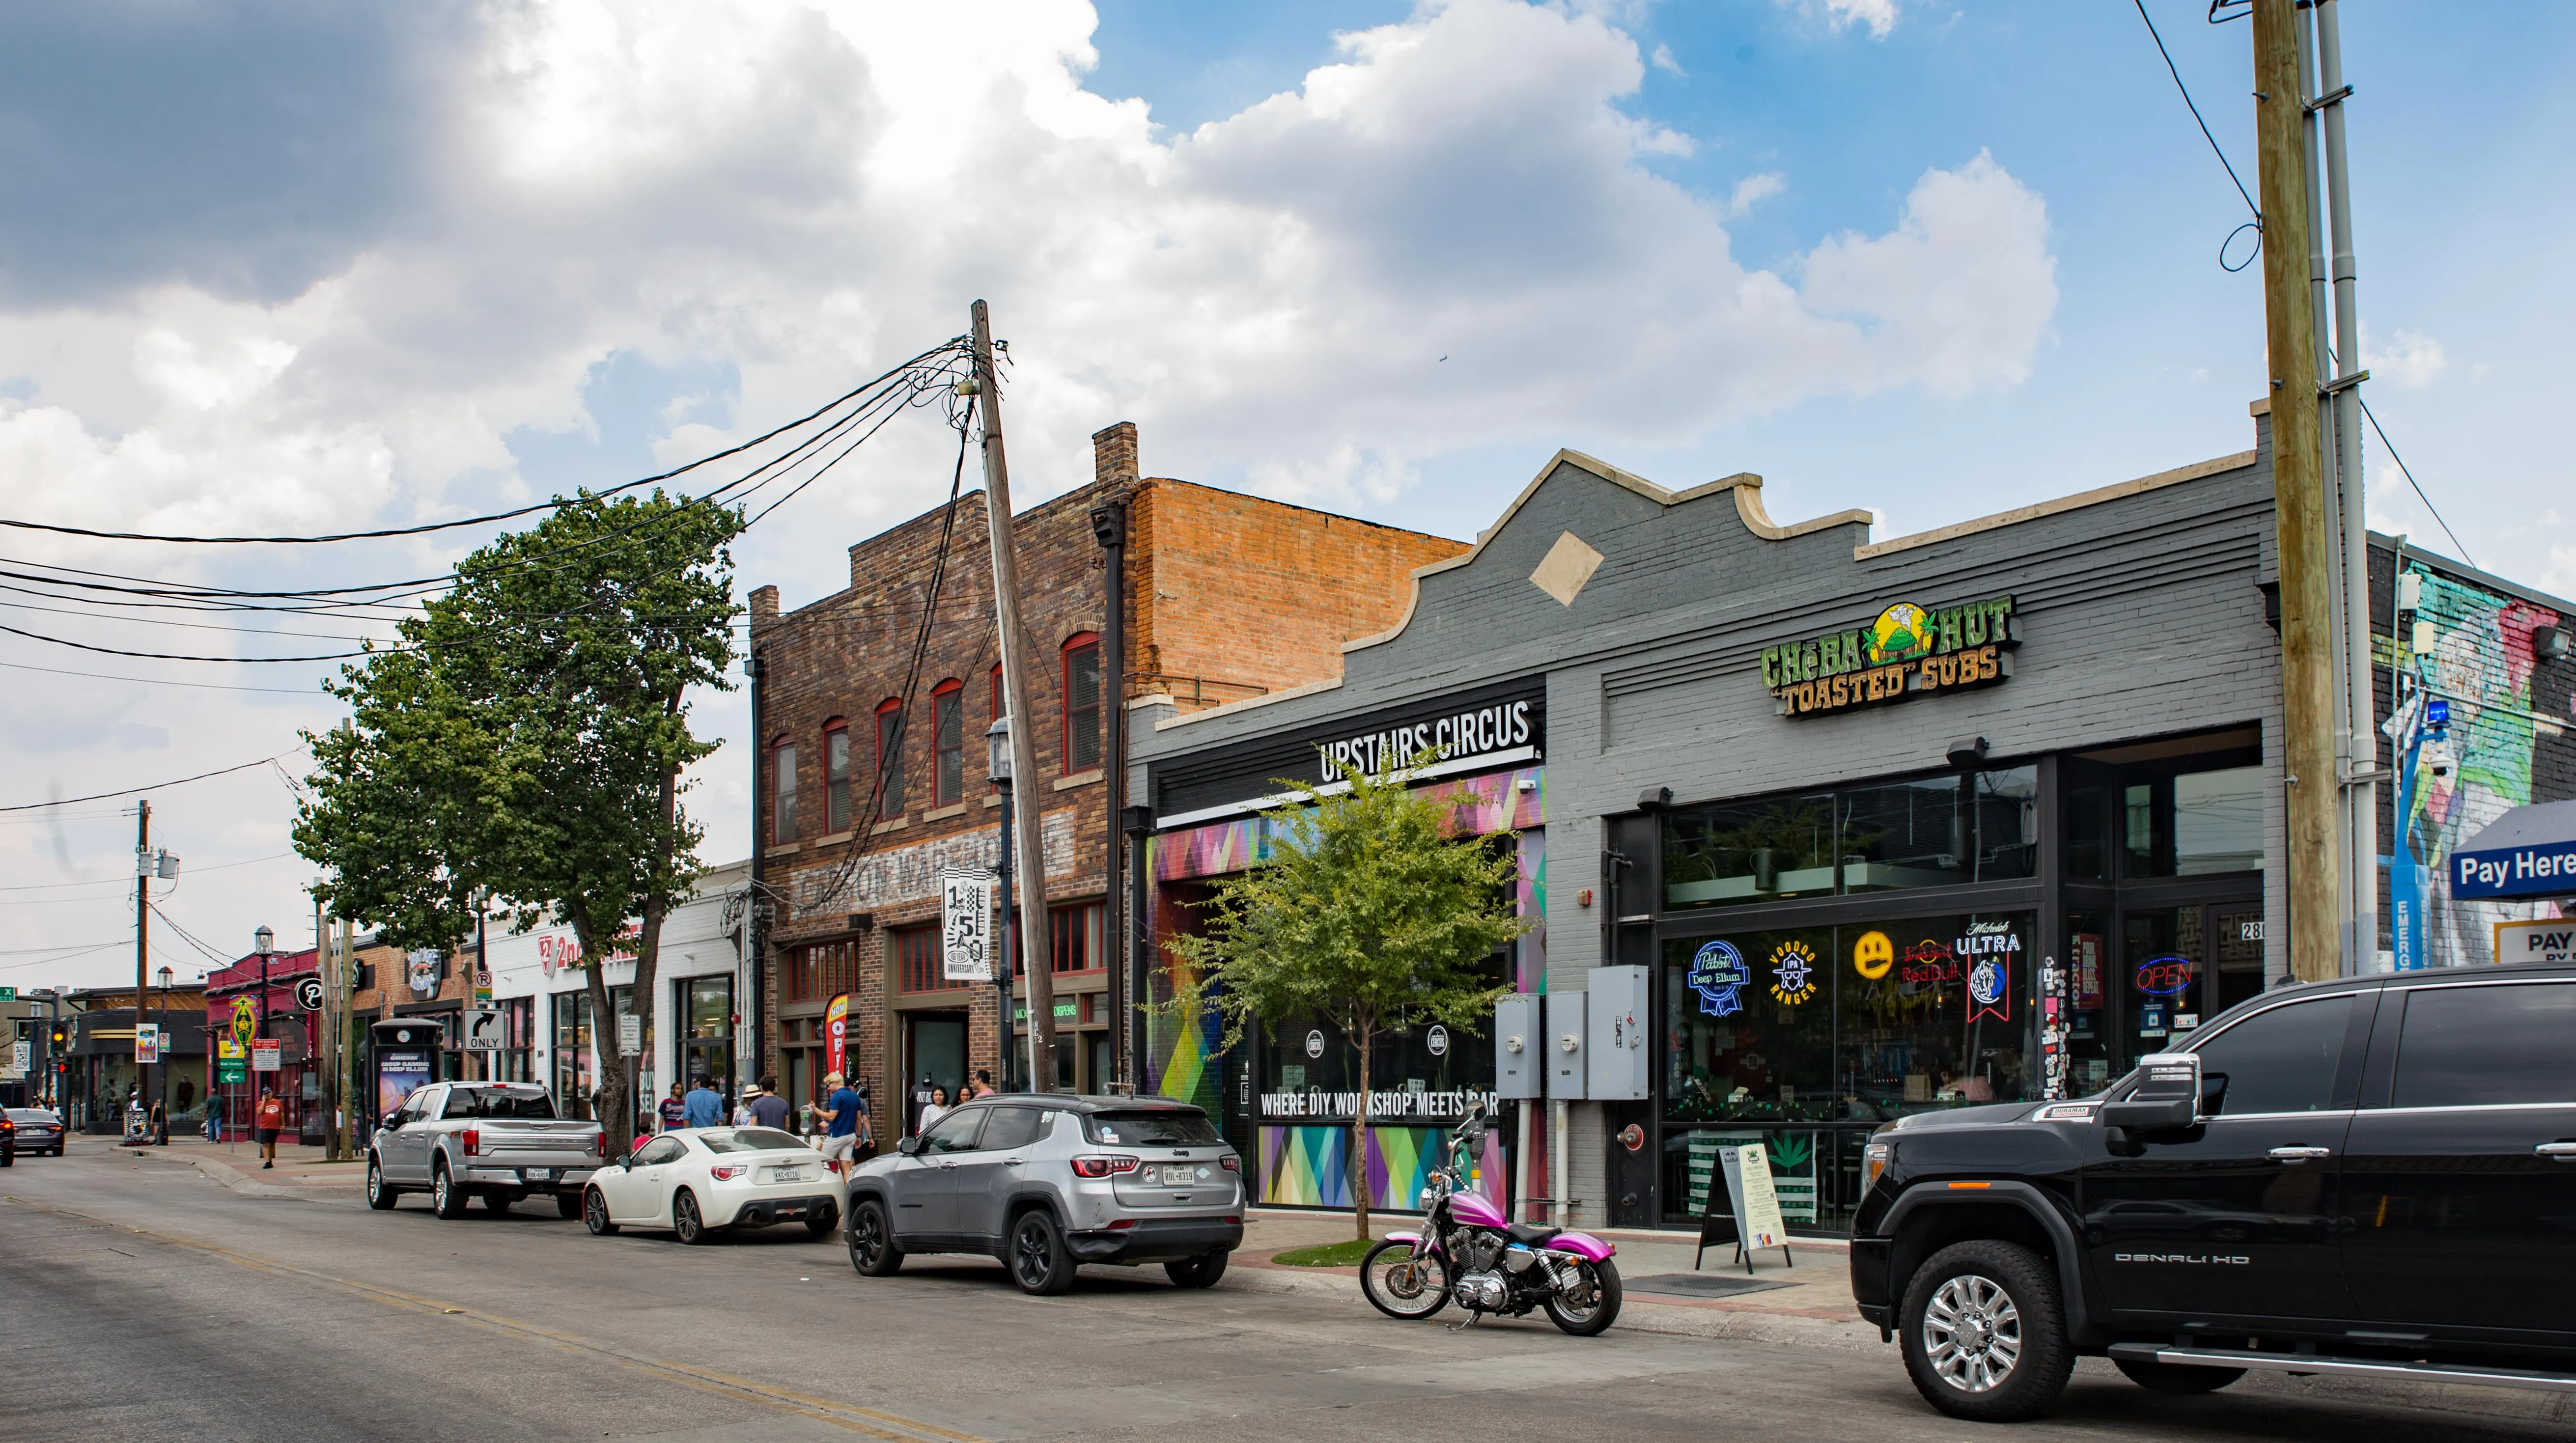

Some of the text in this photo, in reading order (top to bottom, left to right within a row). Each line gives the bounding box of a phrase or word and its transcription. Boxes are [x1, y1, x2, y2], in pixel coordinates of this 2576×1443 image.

[1937, 593, 2012, 654] HUT
[1920, 645, 1998, 691] SUBS
[1320, 701, 1529, 782] UPSTAIRS CIRCUS
[2460, 851, 2576, 888] Pay Here
[1966, 921, 2010, 936] Michelob
[2398, 900, 2410, 972] EMERG
[1957, 934, 2020, 955] ULTRA
[2528, 932, 2574, 951] PAY
[1700, 951, 1732, 970] Pabst
[1769, 941, 1815, 964] VOODOO
[948, 963, 974, 973] ANNIVERSARY
[1787, 960, 1798, 969] IPA
[1693, 972, 1741, 985] Deep Ellum
[2137, 962, 2193, 989] OPEN
[1770, 983, 1817, 1005] RANGER
[831, 1002, 845, 1018] NOW
[471, 1038, 499, 1048] ONLY
[1309, 1042, 1321, 1051] CIRCUS
[1430, 1037, 1445, 1047] CIRCUS
[1261, 1093, 1305, 1115] WHERE
[1310, 1093, 1330, 1115] DIY
[1417, 1092, 1464, 1115] MEETS
[2115, 1254, 2250, 1264] DENALI HD
